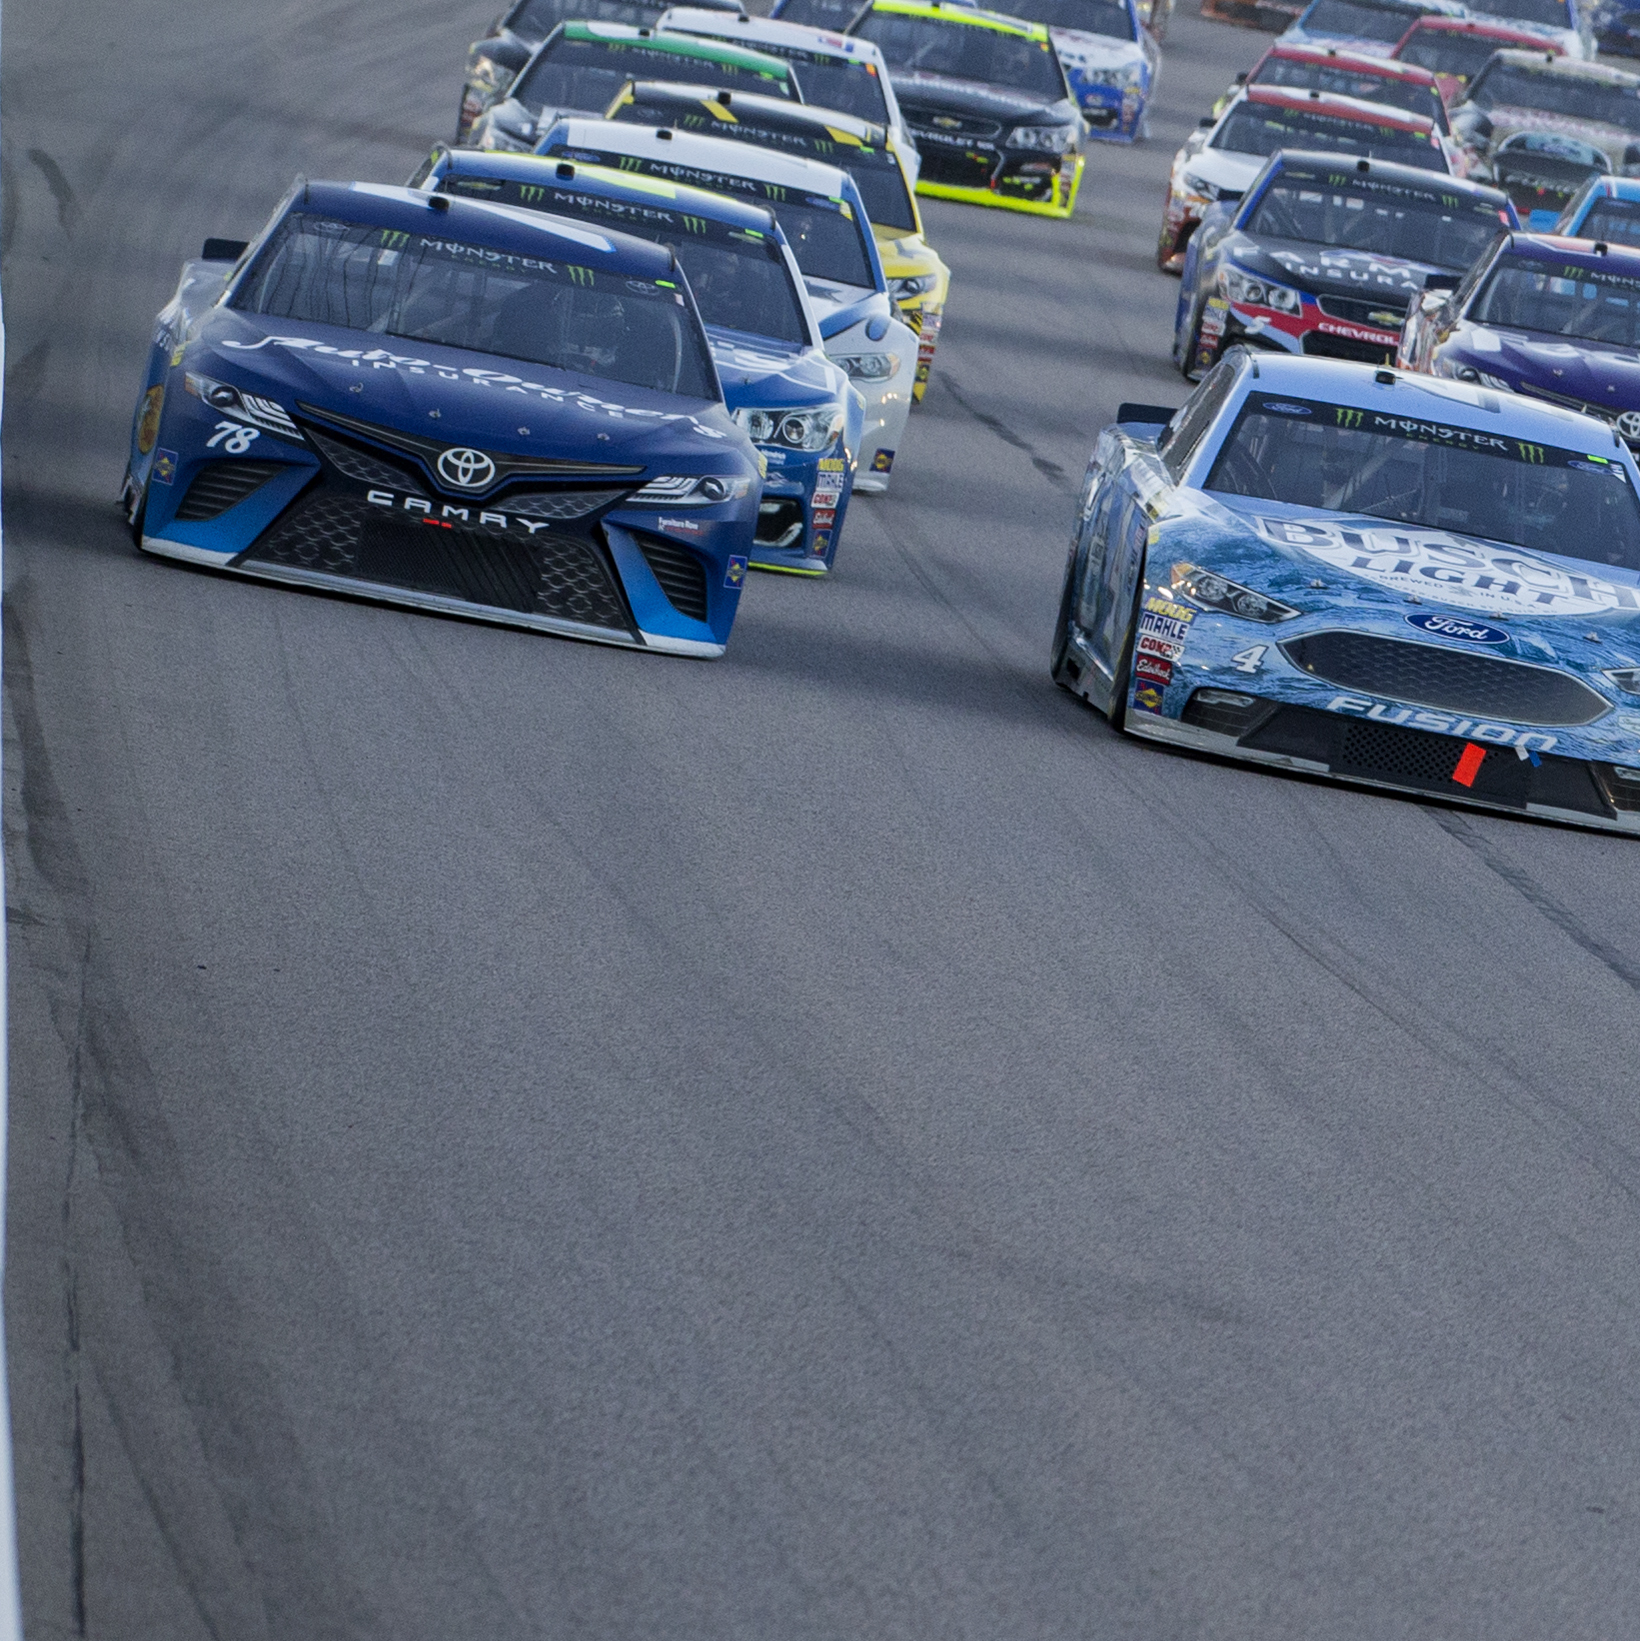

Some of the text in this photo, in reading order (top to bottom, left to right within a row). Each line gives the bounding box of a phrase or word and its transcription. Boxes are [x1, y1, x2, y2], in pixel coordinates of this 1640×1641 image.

[553, 190, 674, 224] MONSTER
[418, 237, 560, 275] MONSTER
[1233, 244, 1411, 278] FARM
[1284, 262, 1418, 291] INSURA
[1317, 321, 1400, 347] CHEVROL
[222, 334, 727, 440] Auto-Owners
[351, 358, 626, 420] INSURANCE
[206, 420, 261, 454] 78
[1374, 415, 1510, 452] MONSTER
[367, 489, 551, 534] CAMRY
[1351, 556, 1570, 606] LIGHT
[1378, 574, 1444, 589] BREWED
[1145, 597, 1197, 622] MOOG
[1140, 613, 1188, 641] MAHLE
[1424, 616, 1488, 640] Ford
[1231, 644, 1269, 673] 4
[1326, 696, 1558, 752] FUSION
